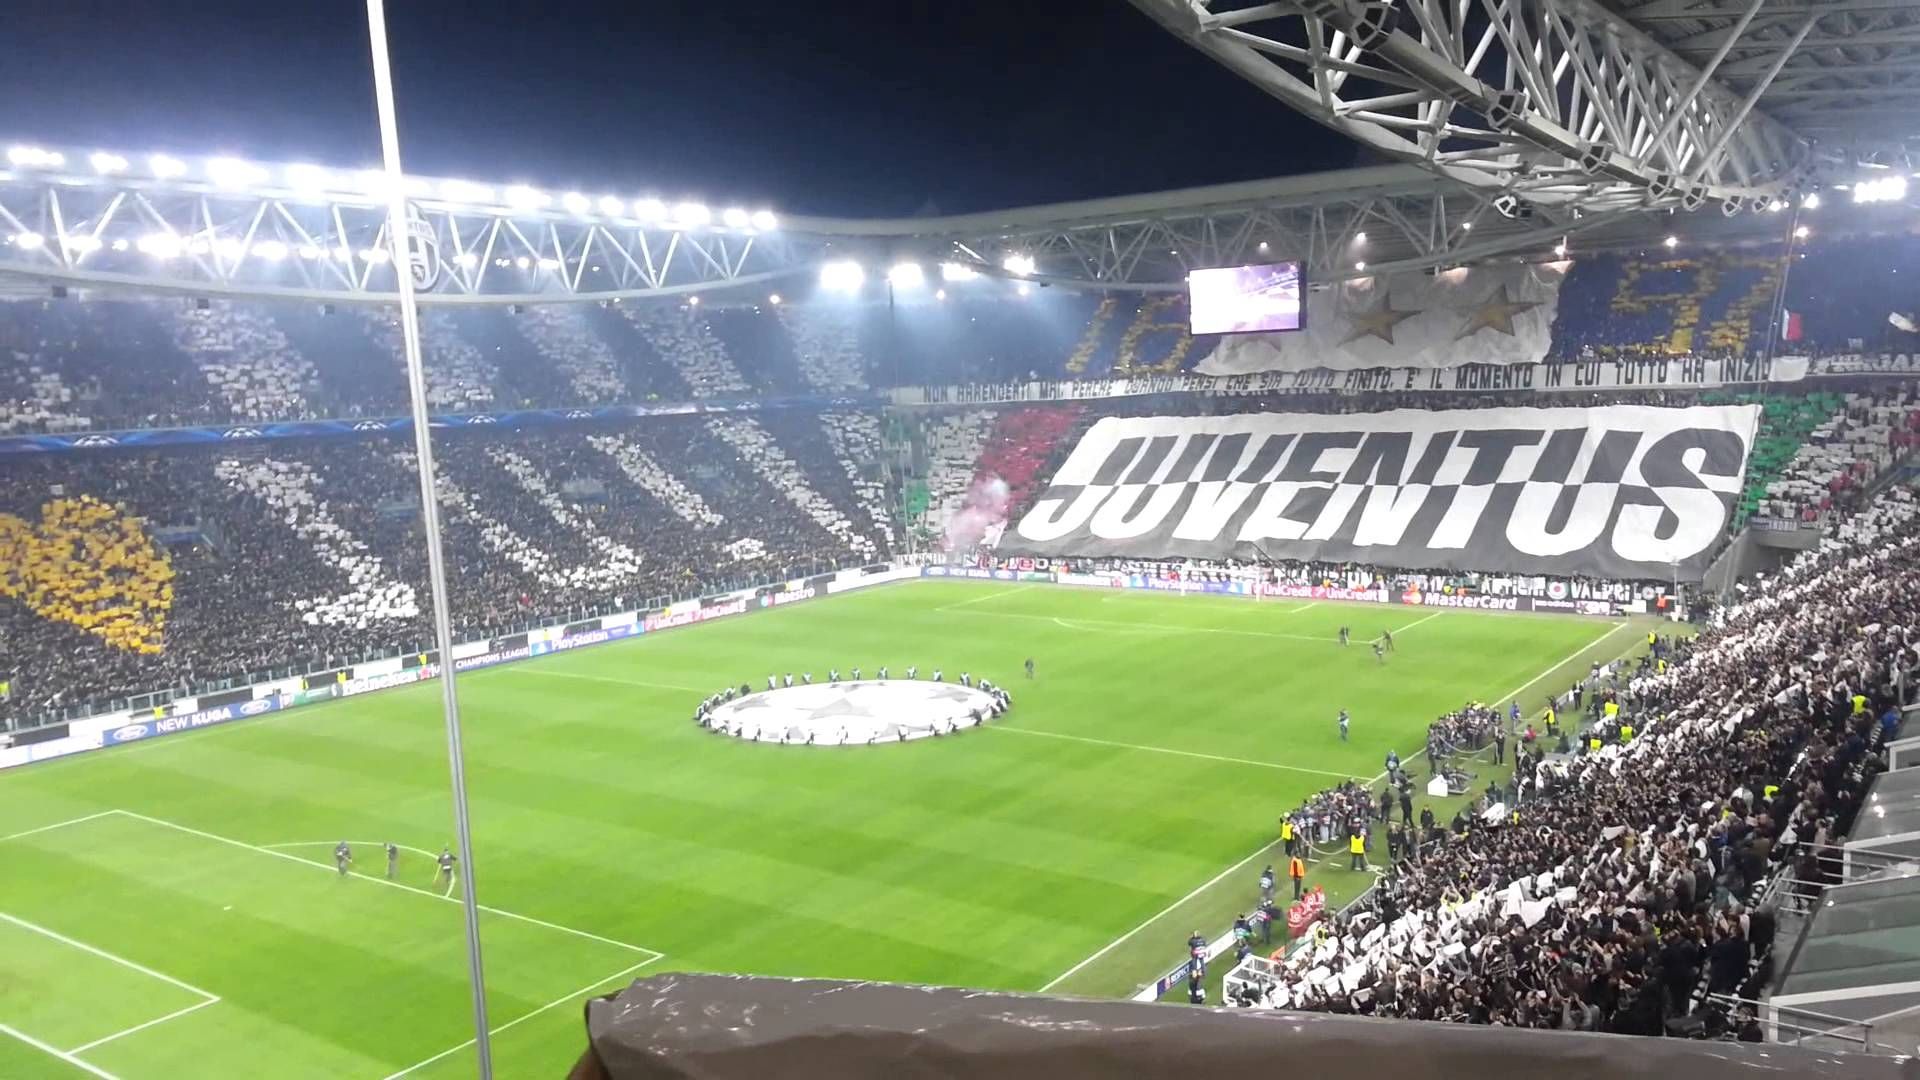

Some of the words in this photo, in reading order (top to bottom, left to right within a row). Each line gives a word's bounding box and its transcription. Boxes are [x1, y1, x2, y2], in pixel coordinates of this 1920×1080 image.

[1430, 367, 1443, 389] IL
[1455, 364, 1534, 388] MOMENTO
[1546, 363, 1562, 387] IN
[1575, 361, 1601, 386] CUI
[1615, 359, 1669, 385] TUTTO
[1682, 359, 1704, 383] HA
[1017, 426, 1745, 563] JUVENTUS
[774, 588, 815, 605] Maestro
[1424, 592, 1517, 610] MasterCard
[551, 630, 608, 651] PlayStation
[455, 652, 500, 669] CHAMPIONS
[502, 646, 529, 660] LEAGUE
[156, 717, 188, 733] NEW
[192, 707, 232, 726] KUGA
